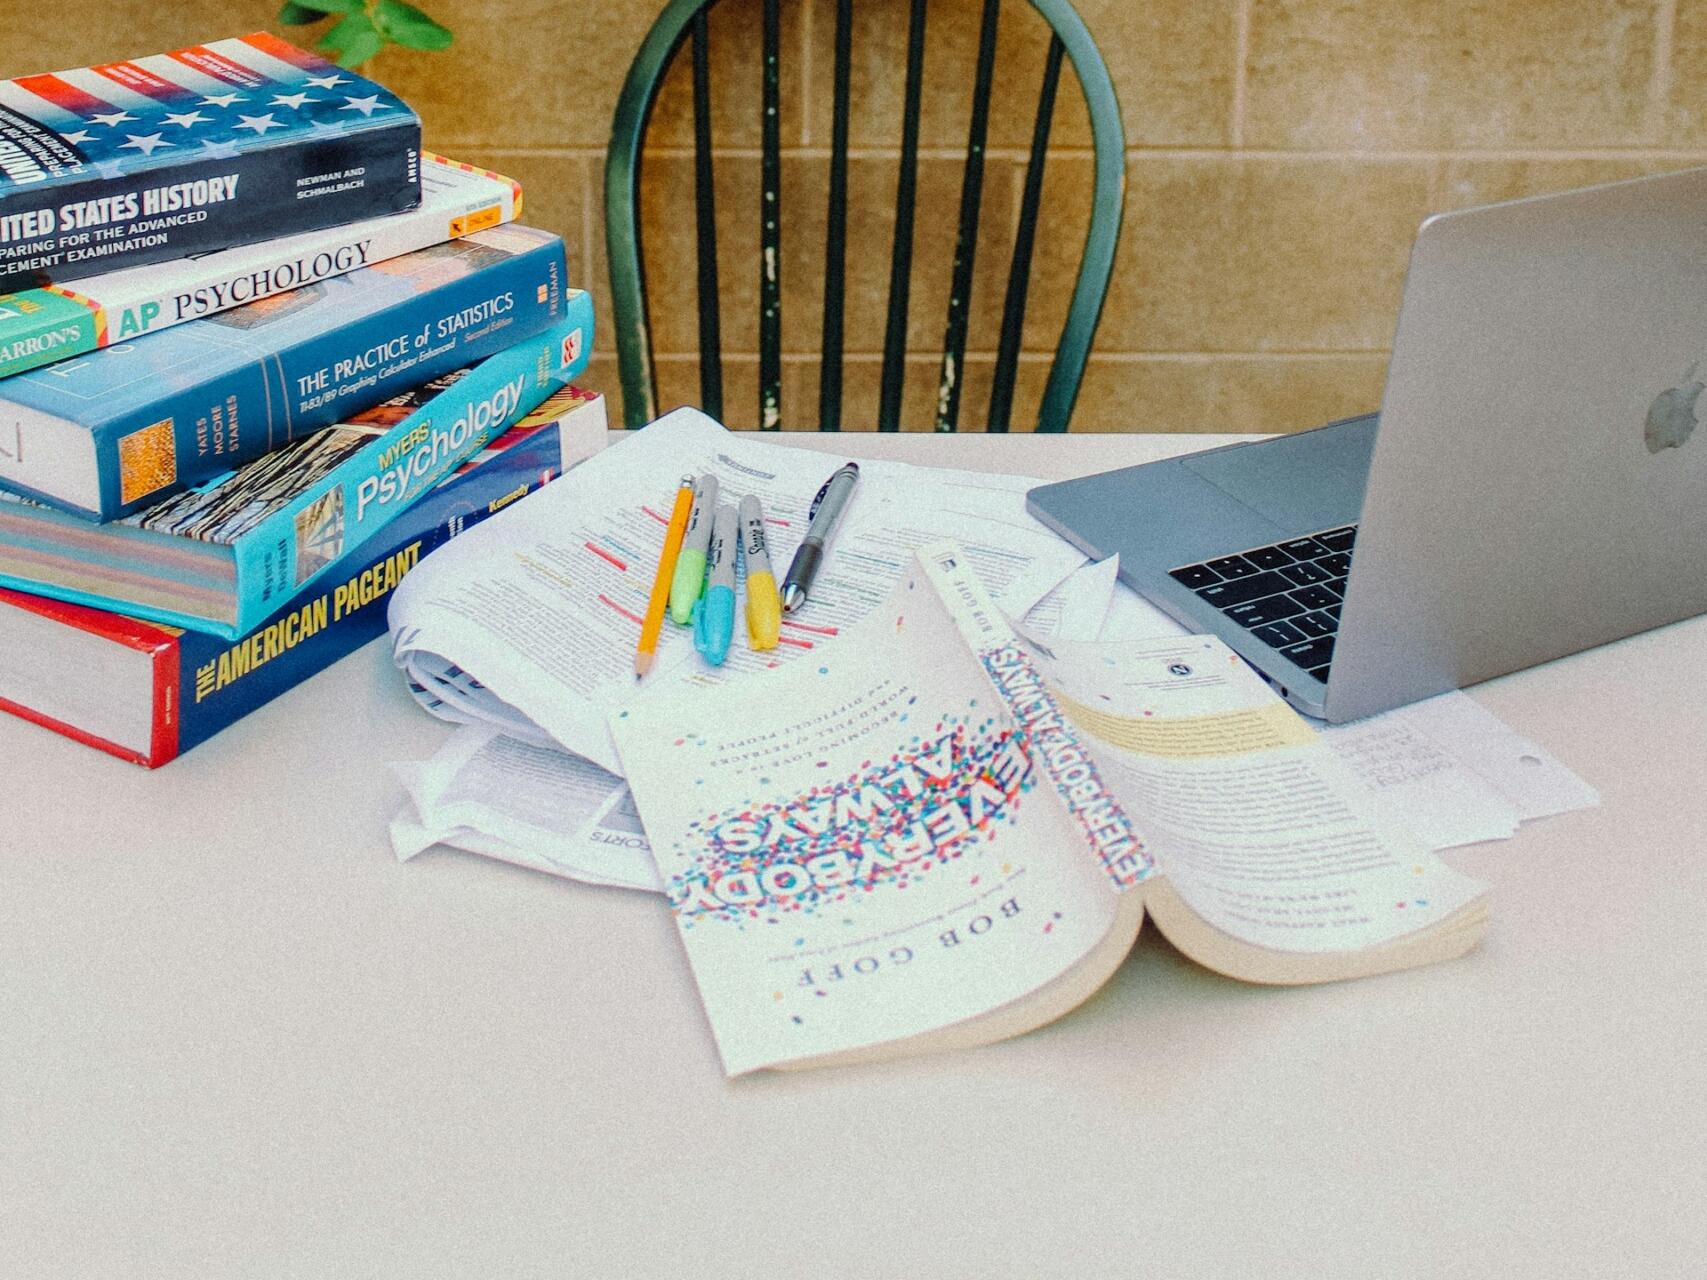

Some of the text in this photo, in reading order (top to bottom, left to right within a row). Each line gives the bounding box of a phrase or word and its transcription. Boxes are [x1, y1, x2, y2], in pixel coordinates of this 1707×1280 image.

[296, 167, 365, 187] NEWMAN AND
[296, 179, 365, 200] SCHMALBACH
[0, 173, 240, 243] ITED STATES HISTORY
[0, 210, 208, 260] PARING FOR THE ADVANCED
[0, 232, 168, 276] CEMENT EXAMINATION
[175, 239, 373, 320] PSYCHOLOGY
[549, 261, 559, 316] FREEMAN
[0, 325, 81, 363] ARRON'S
[297, 291, 514, 398] THE PRACTICE of STATISTICS
[338, 373, 377, 397] Graphing
[378, 354, 418, 380] Calculator
[418, 337, 456, 363] Enhanced
[196, 417, 208, 457] YATES
[211, 404, 224, 455] MOORE
[226, 394, 239, 452] STARNES
[357, 373, 526, 522] Psychology
[195, 540, 422, 704] THE AMERICAN PAGEANT
[815, 718, 854, 738] FULL
[859, 685, 909, 720] WORLD
[717, 731, 778, 752] PEOPLE
[818, 709, 898, 753] BECOMING
[771, 750, 814, 768] LOVE
[991, 647, 1063, 737] ALWAYS
[1048, 733, 1146, 881] EVERYBODY
[715, 731, 956, 854] ALWAYS
[675, 734, 1033, 913] EVERYBODY
[938, 896, 1022, 949] BOB
[797, 945, 914, 988] GOFF
